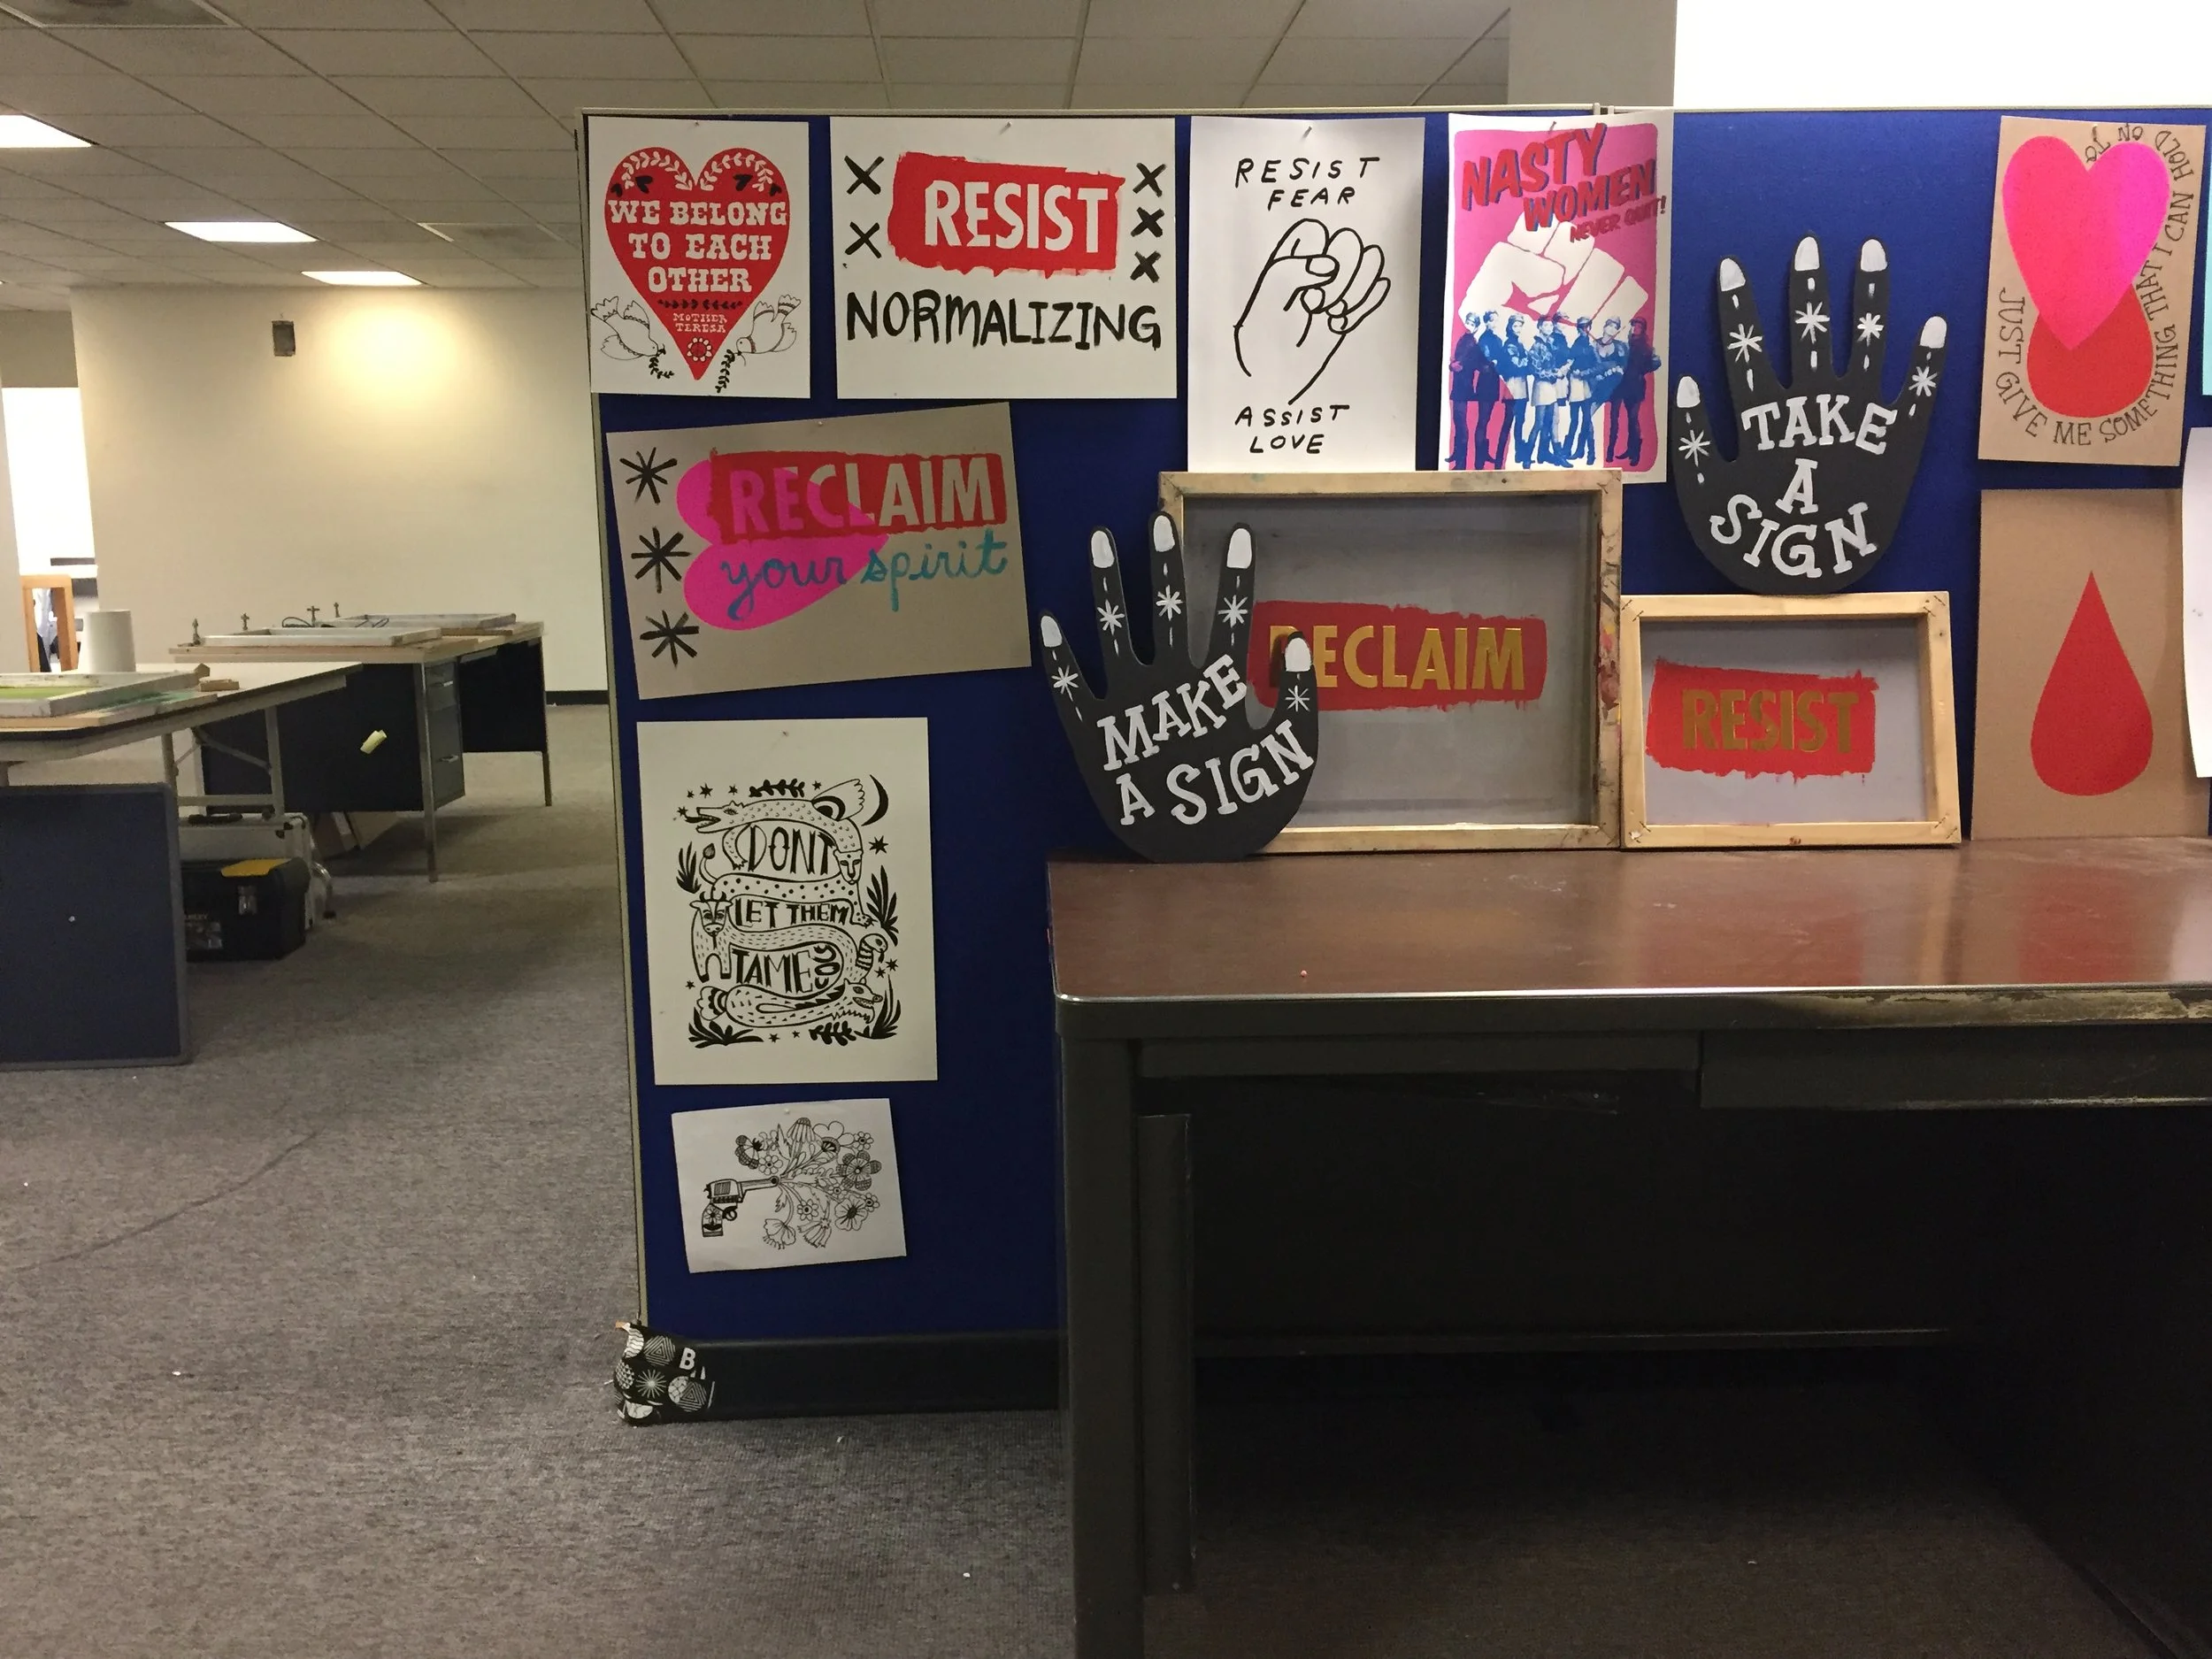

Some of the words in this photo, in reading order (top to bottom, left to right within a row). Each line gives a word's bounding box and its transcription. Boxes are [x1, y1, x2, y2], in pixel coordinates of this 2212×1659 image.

[2085, 137, 2111, 163] TO
[2117, 123, 2143, 142] ON
[2154, 130, 2194, 180] HOLD
[1235, 157, 1379, 188] RESIST
[1462, 123, 1607, 211] NASTY
[607, 200, 660, 224] WE
[670, 202, 787, 226] BELONG
[924, 180, 1108, 253] RESIST
[1268, 187, 1356, 211] FEAR
[1523, 158, 1656, 231] WOMEN
[2164, 190, 2194, 242] CAN
[628, 232, 671, 259] TO
[685, 234, 772, 260] EACH
[1570, 214, 1621, 243] NEVER
[2152, 242, 2172, 256] I
[648, 266, 752, 293] OTHER
[2136, 260, 2170, 320] THAT
[672, 312, 727, 324] MOTHER
[675, 323, 726, 333] TERESA
[847, 289, 1161, 350] NORMALIZING
[1998, 288, 2025, 364] JUST
[1995, 372, 2048, 437] GIVE
[2099, 324, 2178, 442] SOMETHING
[1235, 404, 1349, 426] ASSIST
[1741, 394, 1898, 455] TAKE
[2053, 420, 2093, 445] ME
[1249, 434, 1325, 453] LOVE
[729, 457, 995, 534] RECLAIM
[1775, 458, 1818, 514] A
[1709, 494, 1878, 578] SIGN
[719, 556, 848, 619] your
[861, 528, 1008, 612] spirit
[1097, 654, 1248, 771] MAKE
[1682, 689, 1858, 754] RESIST
[1116, 772, 1156, 826] A
[1166, 718, 1314, 826] SIGN
[748, 825, 837, 875] DONT
[735, 898, 780, 929] LET
[787, 903, 850, 926] THEM
[732, 948, 813, 994] TAME
